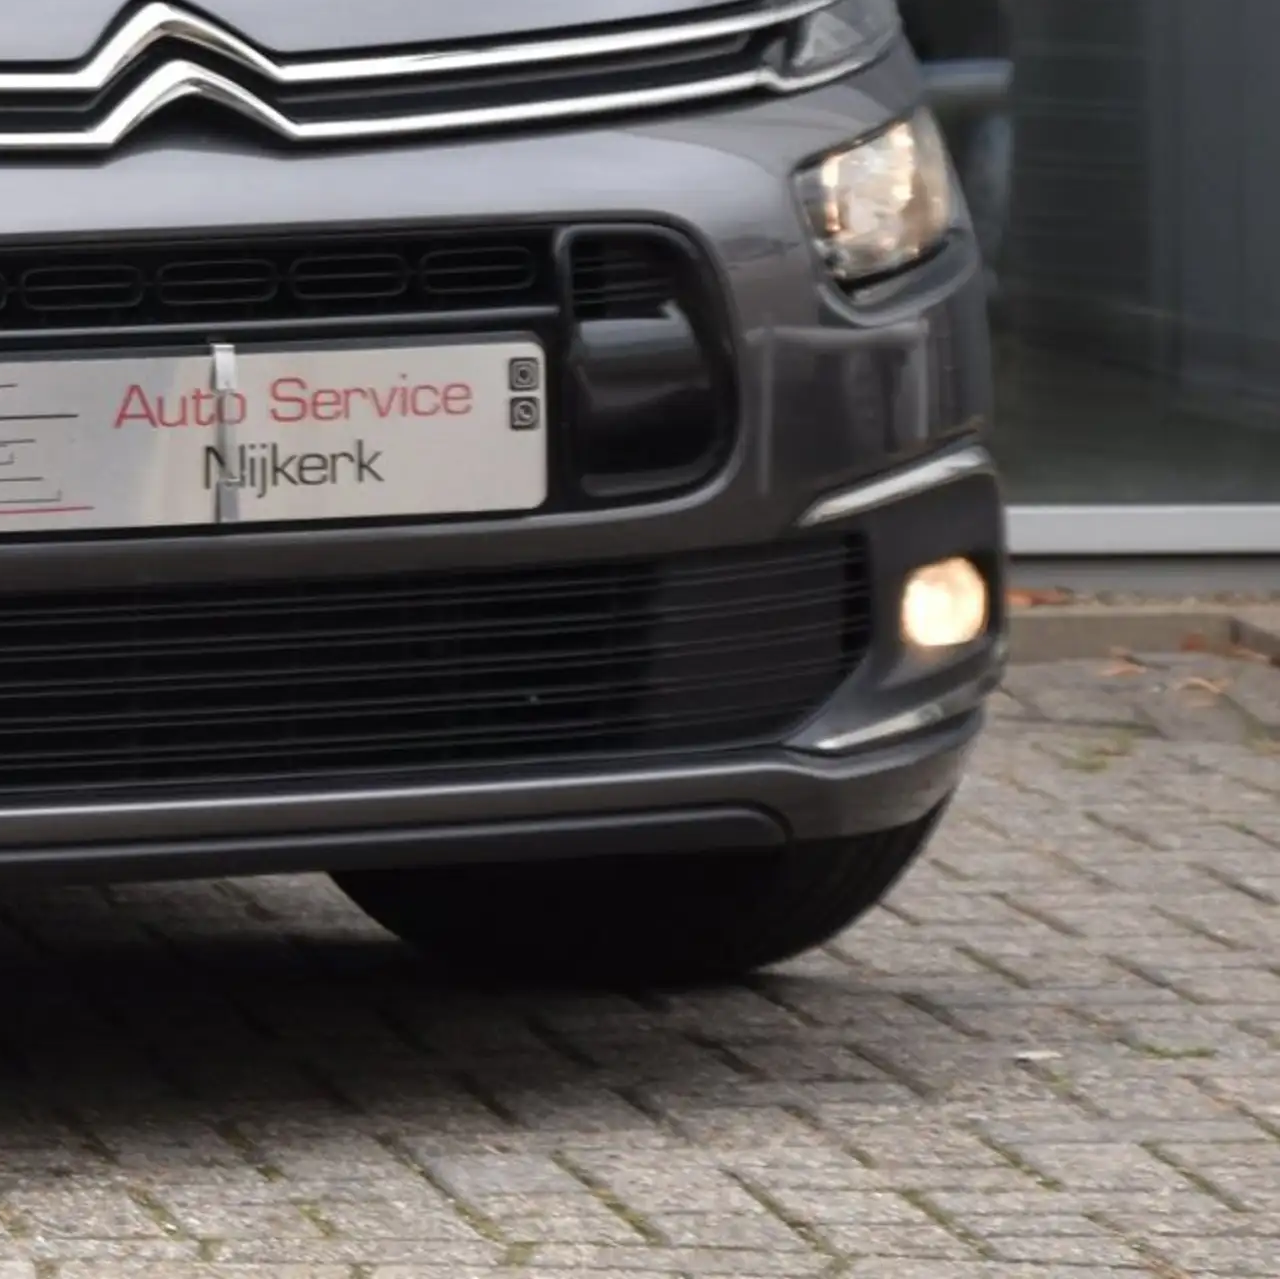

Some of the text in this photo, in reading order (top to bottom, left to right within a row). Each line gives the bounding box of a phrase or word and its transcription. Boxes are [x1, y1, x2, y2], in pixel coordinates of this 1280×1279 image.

[114, 373, 473, 429] Auto Service
[203, 439, 385, 499] Nijkerk
